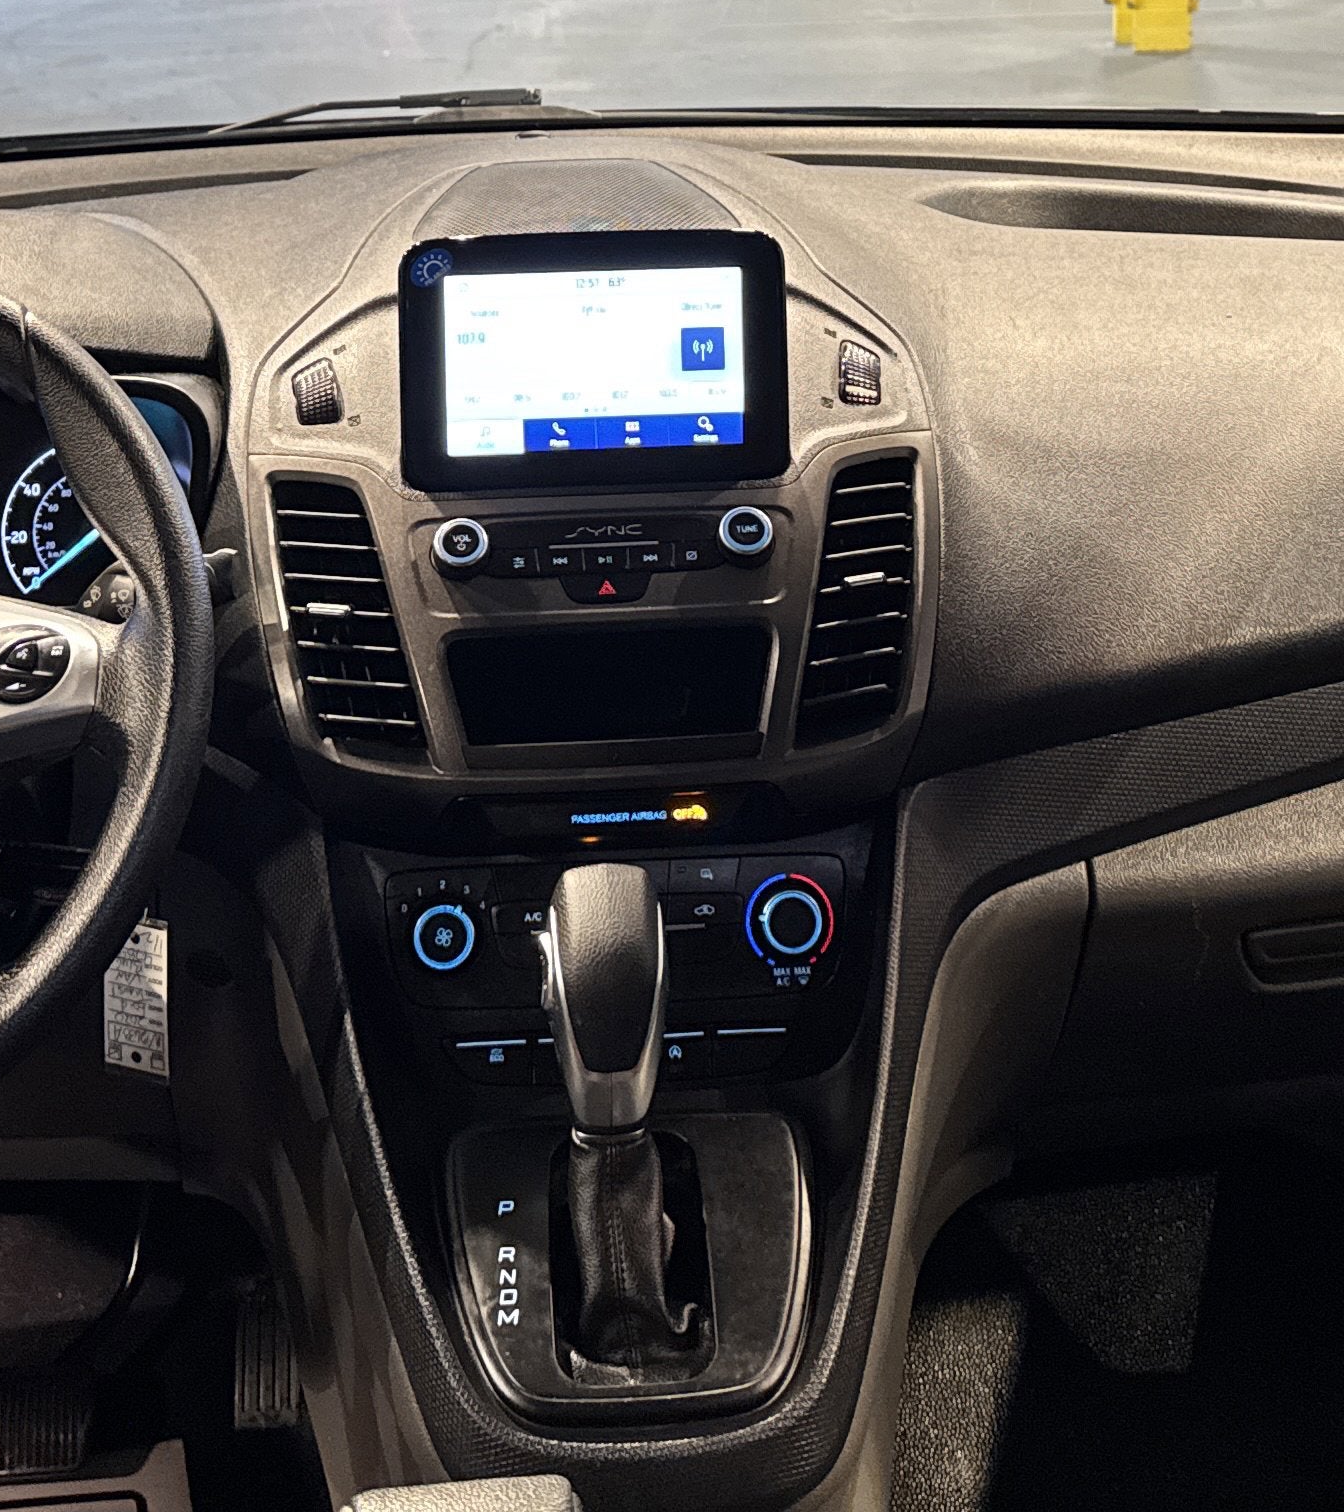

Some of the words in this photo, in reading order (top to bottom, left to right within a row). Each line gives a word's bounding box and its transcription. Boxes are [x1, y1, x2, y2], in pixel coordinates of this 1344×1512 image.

[22, 482, 41, 497] 40
[47, 503, 60, 513] 60
[42, 521, 54, 531] 40
[564, 522, 643, 539] SYNC
[735, 522, 759, 534] TUNE
[10, 529, 28, 544] 20
[451, 533, 472, 544] VOL
[570, 812, 630, 825] PASSENGER
[630, 809, 668, 822] AIRBAG
[672, 807, 694, 821] OFF
[439, 879, 446, 890] 2
[463, 884, 471, 895] 3
[417, 887, 422, 897] 1
[401, 903, 408, 913] 0
[479, 900, 486, 910] 4
[523, 911, 543, 923] A/C
[773, 967, 791, 977] MAX
[793, 965, 812, 976] MAX
[498, 1200, 515, 1217] P
[498, 1246, 516, 1263] R
[499, 1268, 517, 1286] N
[499, 1288, 518, 1306] D
[497, 1308, 520, 1327] M
